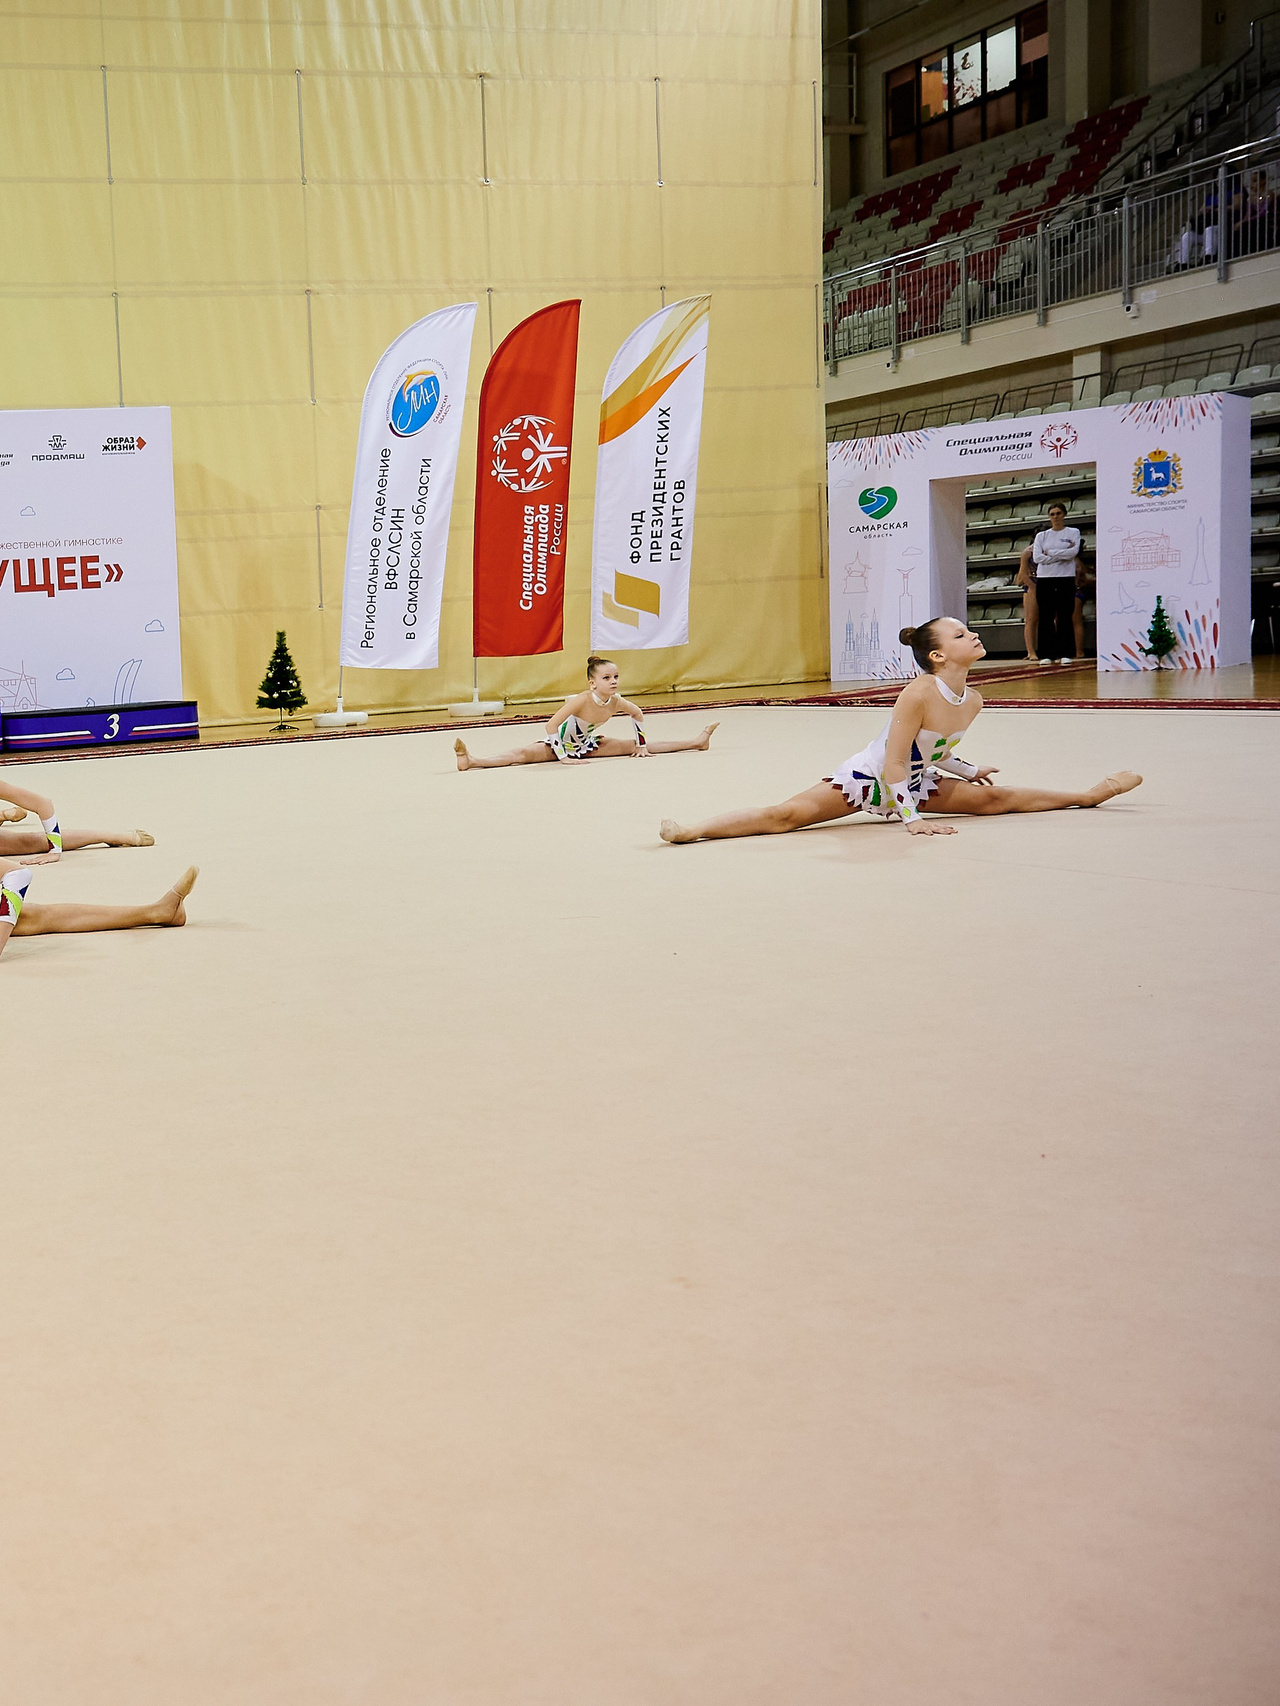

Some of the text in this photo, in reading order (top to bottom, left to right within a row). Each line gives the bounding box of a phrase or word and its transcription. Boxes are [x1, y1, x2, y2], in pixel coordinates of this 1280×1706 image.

[102, 444, 135, 452] ЖИЗНИ
[106, 436, 134, 444] ОБРАЗ
[946, 430, 1032, 448] Специальная
[959, 442, 1032, 456] Олимпиада
[32, 453, 85, 462] ПРОДМАШ
[1000, 452, 1032, 462] России
[650, 406, 671, 562] ПРЕЗИДЕНТСКИХ
[550, 504, 564, 555] России
[670, 480, 686, 561] ГРАНТОВ
[848, 521, 908, 534] САМАРСКАЯ
[64, 536, 123, 547] гимнастике
[360, 448, 392, 648] Региональное отделение
[384, 508, 406, 590] ВФСЛСИН
[403, 458, 432, 640] в Самарской области
[630, 510, 646, 564] ФОНД
[863, 532, 892, 540] область
[520, 504, 535, 610] Специальная
[534, 504, 550, 595] Олимпиада
[104, 714, 120, 740] 3
